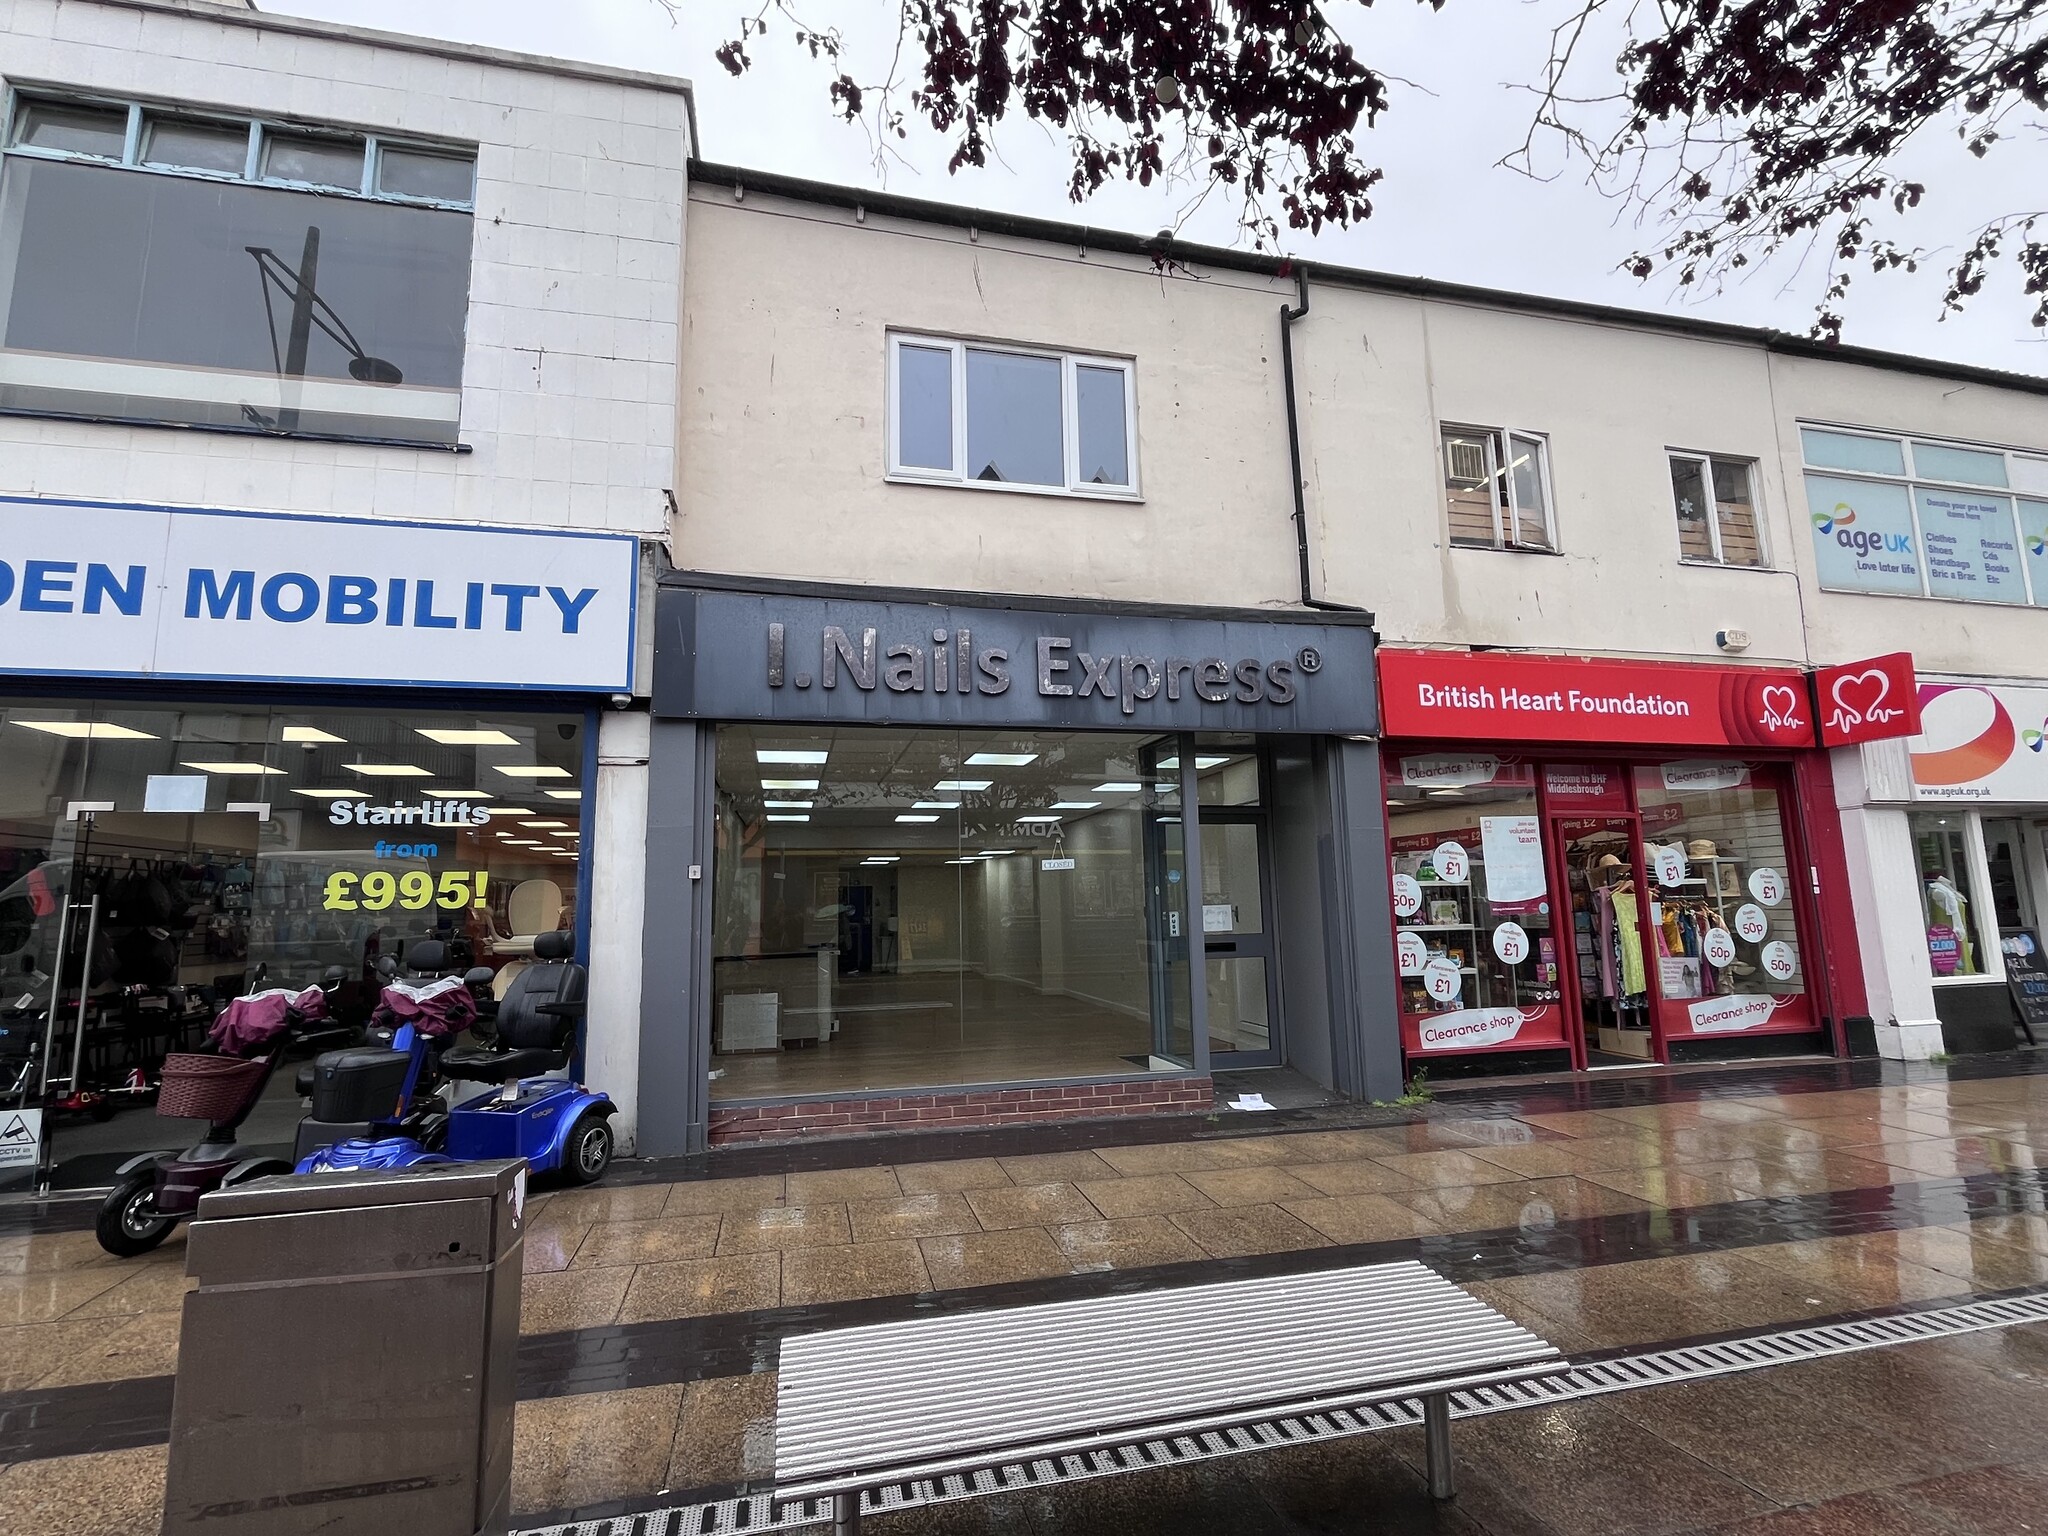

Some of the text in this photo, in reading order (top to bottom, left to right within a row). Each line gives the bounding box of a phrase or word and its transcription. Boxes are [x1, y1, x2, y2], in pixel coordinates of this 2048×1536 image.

[1836, 529, 1912, 558] age UK
[1925, 532, 1957, 544] Clothes
[1980, 539, 2014, 551] Records
[1927, 544, 1954, 556] Shoes
[1856, 560, 1916, 575] Love later life
[1931, 568, 1949, 579] Bric
[1956, 570, 1977, 581] Brac
[1984, 562, 2010, 574] Books
[0, 558, 600, 635] EN MOBILITY
[1418, 682, 1690, 717] British Heart Foundation
[1406, 759, 1492, 780] Clearance shop
[1666, 763, 1739, 784] Clearance shop
[1546, 773, 1608, 784] Welcome to BHF
[1547, 783, 1605, 796] Middlesbrough
[1920, 786, 1991, 798] www.ageuk.org.uk
[328, 800, 491, 825] Stairlifts
[1663, 808, 1678, 820] £2
[1420, 837, 1429, 847] £3
[1518, 836, 1538, 844] team
[374, 840, 438, 859] from
[1043, 861, 1074, 869] CLOSED
[1445, 861, 1461, 877] £1
[1665, 865, 1680, 881] £1
[322, 870, 489, 911] £995!
[1763, 886, 1777, 899] £1
[1393, 894, 1416, 910] 50p
[1742, 922, 1763, 936] 50p
[1503, 942, 1519, 958] £1
[1710, 946, 1731, 961] 50p
[1401, 952, 1418, 968] £1
[1770, 959, 1792, 975] 50p
[1434, 978, 1451, 995] £1
[1695, 1001, 1768, 1026] Clearance shop
[1424, 1015, 1515, 1042] Clearance shop
